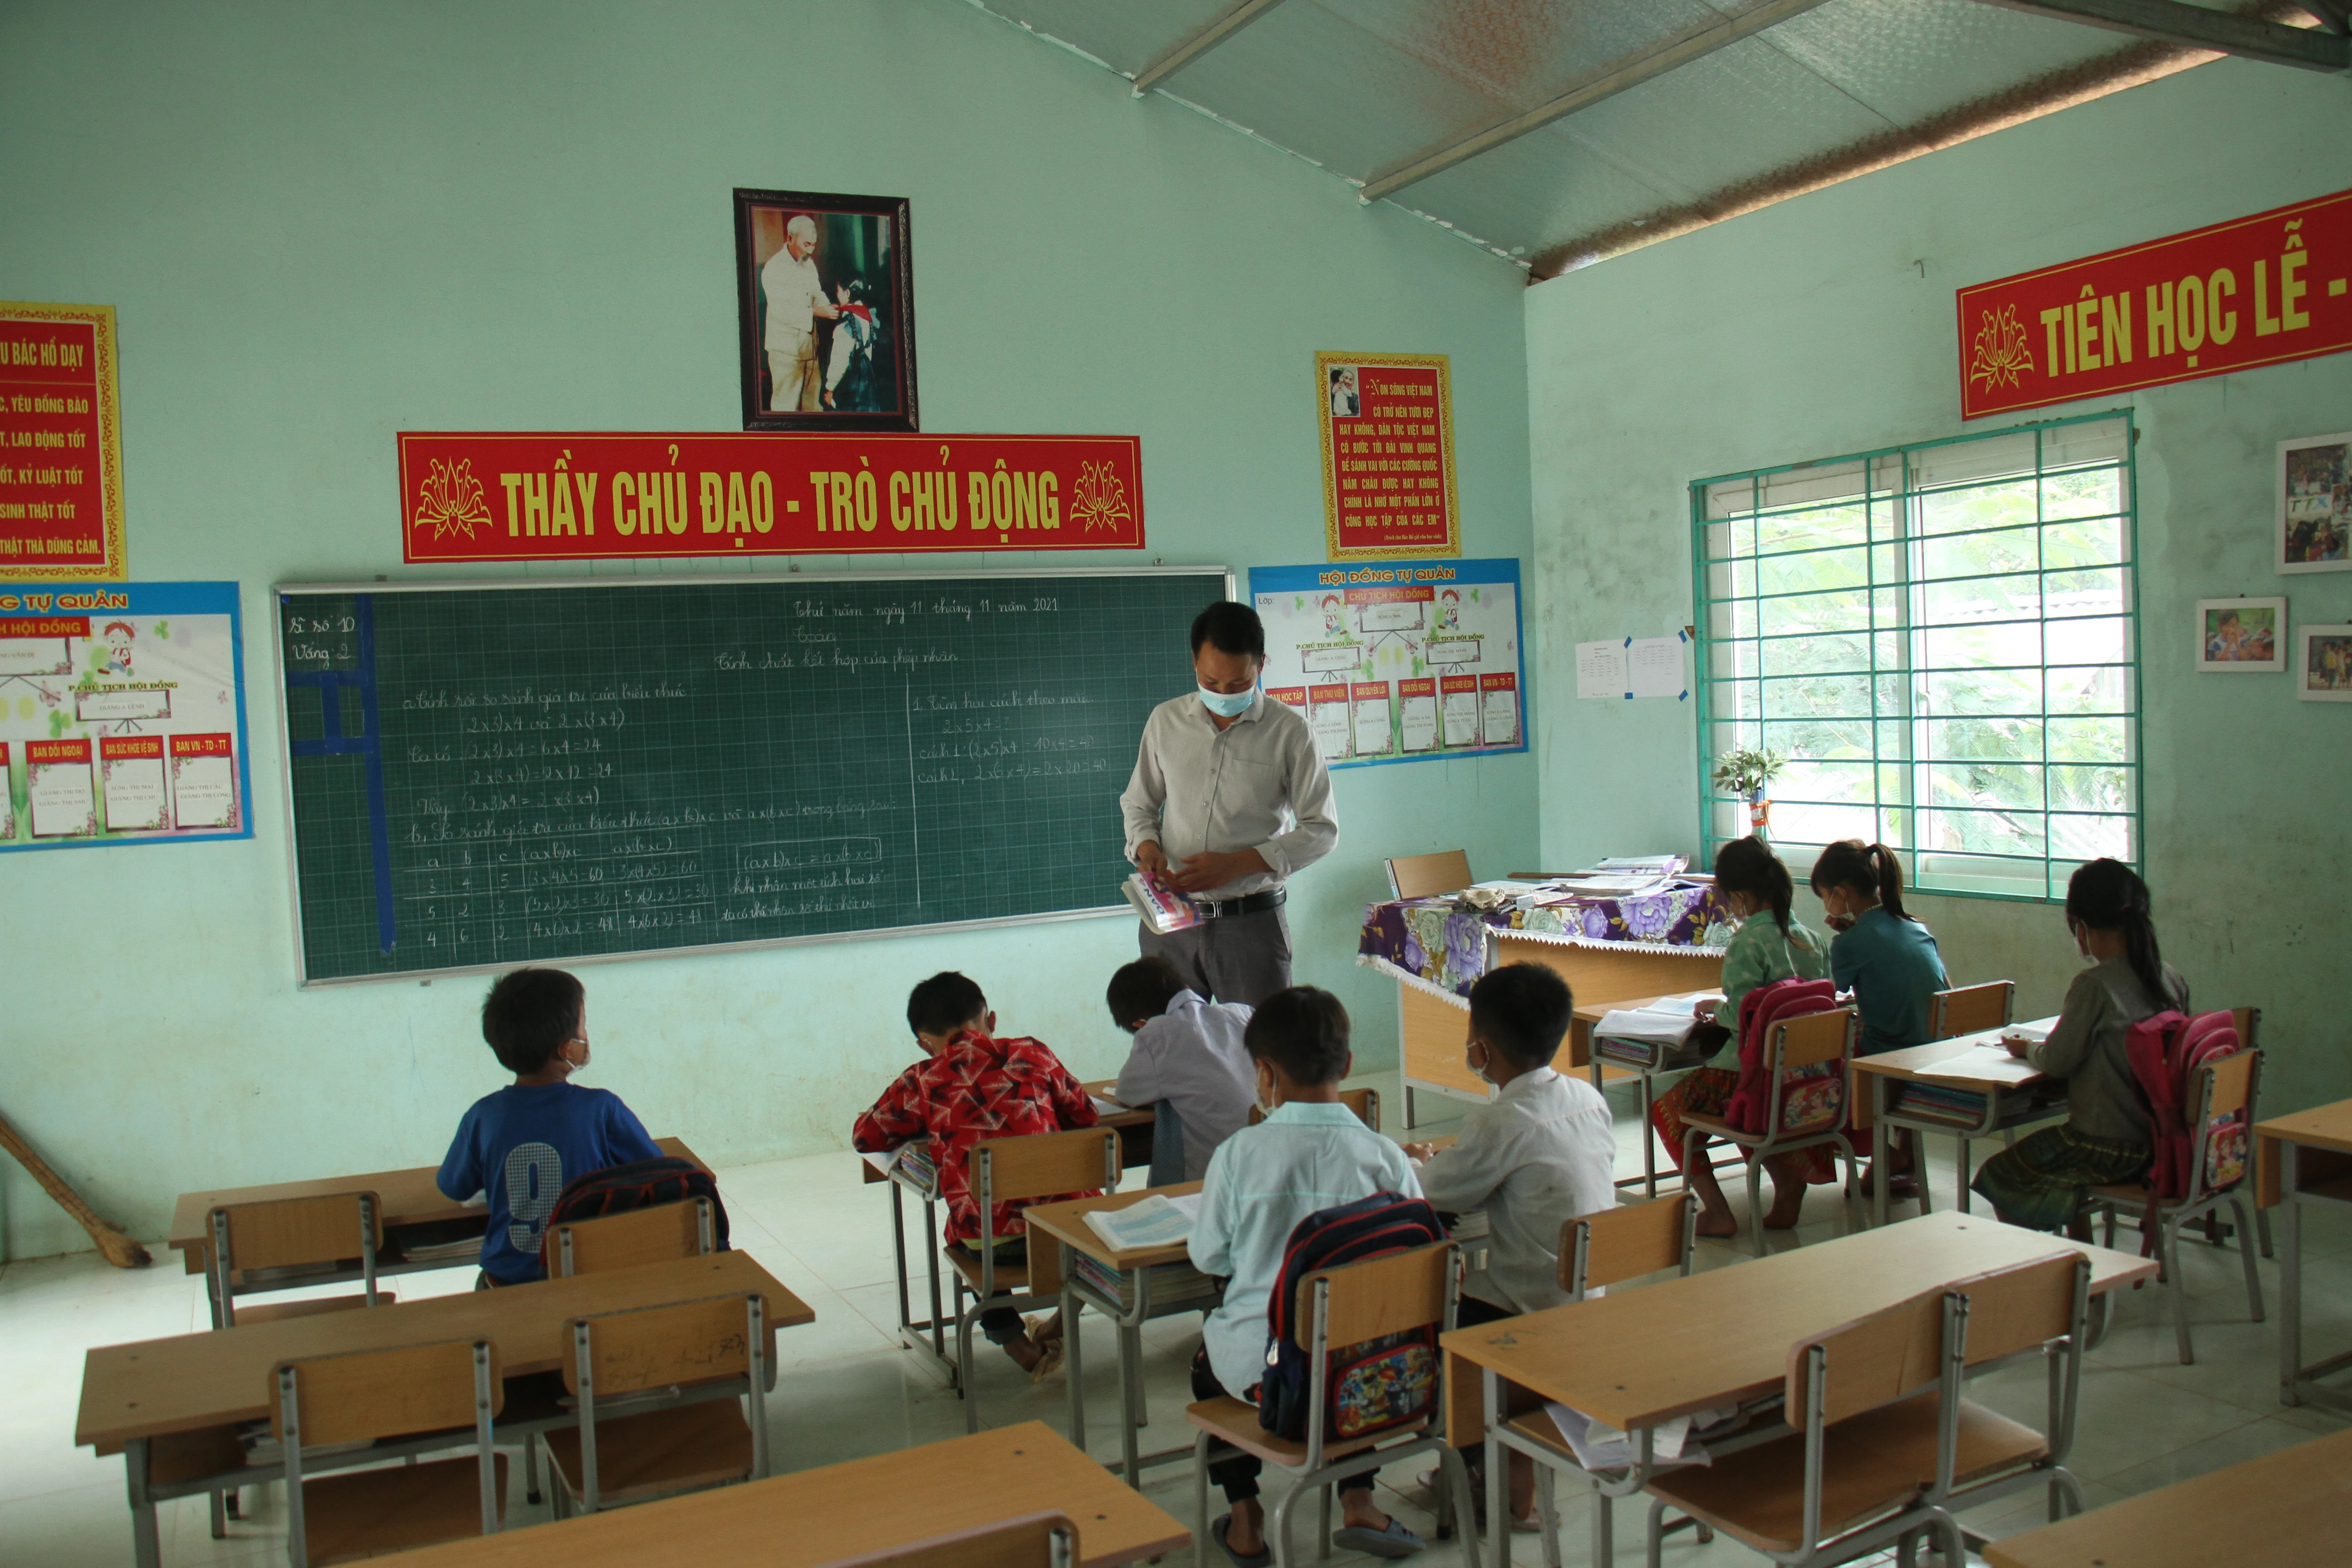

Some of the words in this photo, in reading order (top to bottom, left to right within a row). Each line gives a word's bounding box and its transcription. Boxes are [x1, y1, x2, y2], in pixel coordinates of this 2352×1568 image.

[2040, 284, 2132, 377] TIÊN
[2146, 268, 2236, 368] HỌC
[2254, 218, 2309, 337] LỄ
[12, 338, 37, 366] BÁC
[60, 344, 83, 372] DẠY
[1390, 382, 1405, 395] SÔNG
[1406, 383, 1418, 398] VIỆT
[1420, 385, 1432, 396] NAM
[11, 394, 32, 412] YÊU
[67, 396, 88, 414] BÀO
[12, 432, 32, 447] LAO
[35, 429, 64, 451] ĐỘNG
[68, 428, 86, 448] TỐT
[1339, 424, 1350, 435] HAY
[1354, 422, 1376, 437] KHÔNG,
[1378, 422, 1390, 435] DÂN
[1393, 422, 1404, 437] TỘC
[1407, 423, 1418, 437] VIỆT
[1422, 425, 1435, 435] NAM
[19, 463, 32, 484] KỶ
[35, 466, 62, 488] LUẬT
[64, 465, 83, 485] TỐT
[1343, 477, 1357, 490] NĂM
[1362, 476, 1377, 489] CHÂU
[1382, 477, 1398, 491] ĐƯỢC
[1403, 478, 1414, 489] HAY
[1419, 476, 1438, 488] KHÔNG
[500, 449, 598, 537] THẦY
[612, 444, 688, 535] CHỦ
[700, 471, 774, 547] ĐẠO
[810, 456, 878, 531] TRÒ
[889, 445, 958, 531] CHỦ
[968, 458, 1059, 543] ĐỘNG
[28, 501, 54, 522] THẬT
[57, 498, 75, 519] TỐT
[1319, 572, 1346, 586] HỘI
[1349, 567, 1393, 582] ĐỒNG
[1397, 570, 1412, 583] TỰ
[1415, 565, 1455, 580] QUẢN
[23, 593, 53, 613] TỰ
[56, 589, 128, 609] QUẢN
[11, 620, 35, 636] HỘI
[505, 1142, 562, 1253] 9
